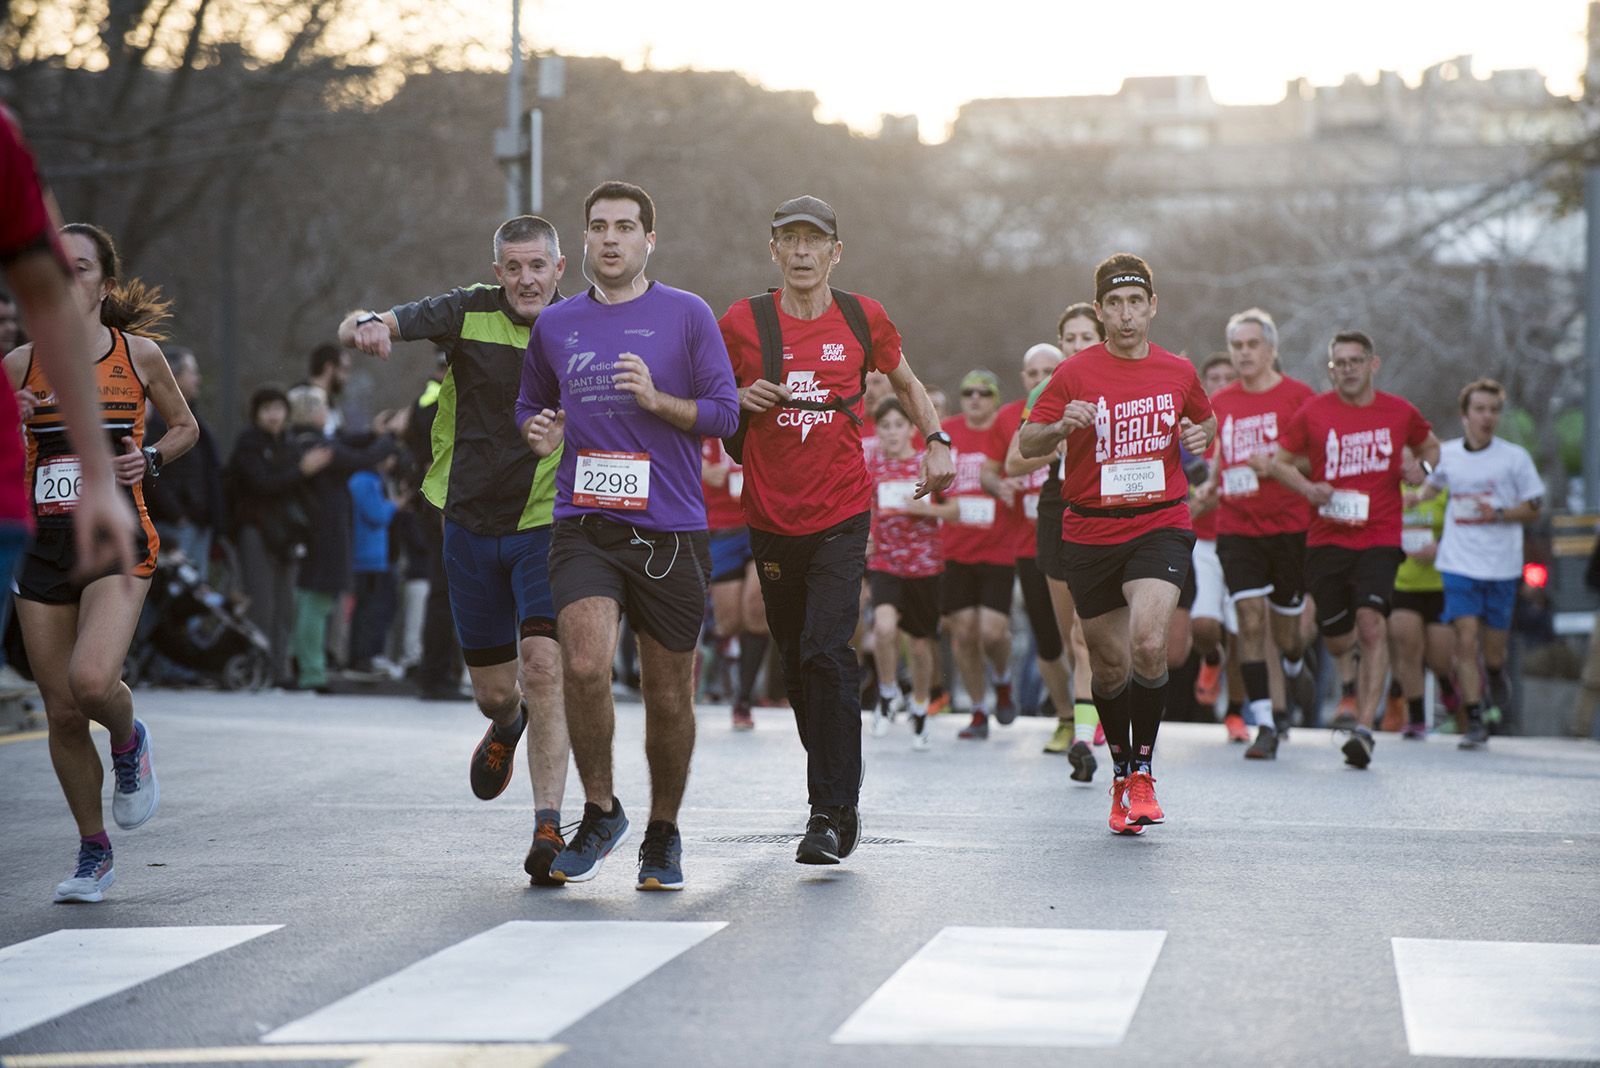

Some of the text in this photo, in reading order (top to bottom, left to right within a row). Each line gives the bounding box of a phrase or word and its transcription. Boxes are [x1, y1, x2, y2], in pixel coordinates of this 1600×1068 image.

[566, 351, 596, 374] 17
[567, 376, 594, 389] SANT
[1115, 393, 1175, 420] CURSA DEL
[776, 409, 837, 426] CUGAT
[1115, 413, 1162, 443] GALL
[1114, 440, 1144, 458] SANT
[583, 471, 638, 494] 2298
[1113, 472, 1155, 482] ANTONIO
[1125, 482, 1144, 492] 395
[44, 476, 83, 499] 206
